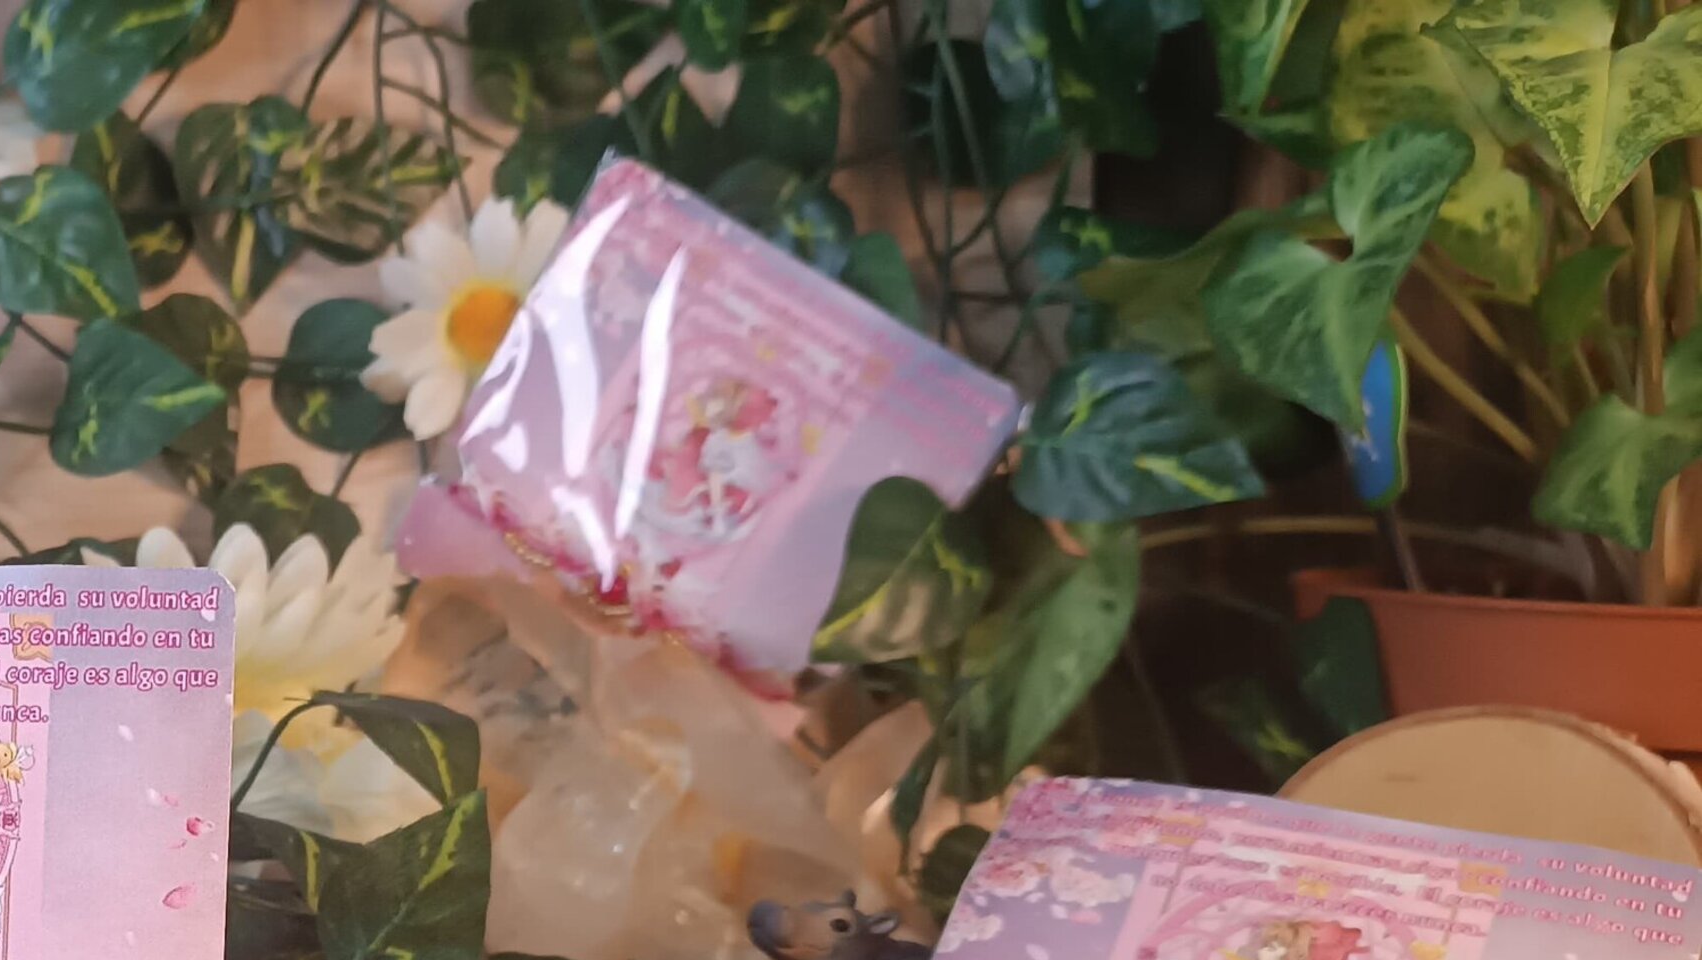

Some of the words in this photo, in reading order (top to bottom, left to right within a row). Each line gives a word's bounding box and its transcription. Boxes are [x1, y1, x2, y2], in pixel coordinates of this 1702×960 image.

[77, 589, 105, 608] su
[111, 585, 219, 611] voluntad
[29, 623, 146, 648] confiando
[153, 630, 182, 648] en
[188, 628, 215, 648] tu
[5, 661, 79, 688] coraje
[83, 666, 110, 684] es
[114, 662, 168, 689] algo
[173, 668, 218, 691] que
[1573, 860, 1694, 897] voluntad
[1654, 902, 1683, 919] tu
[1633, 926, 1684, 944] que
